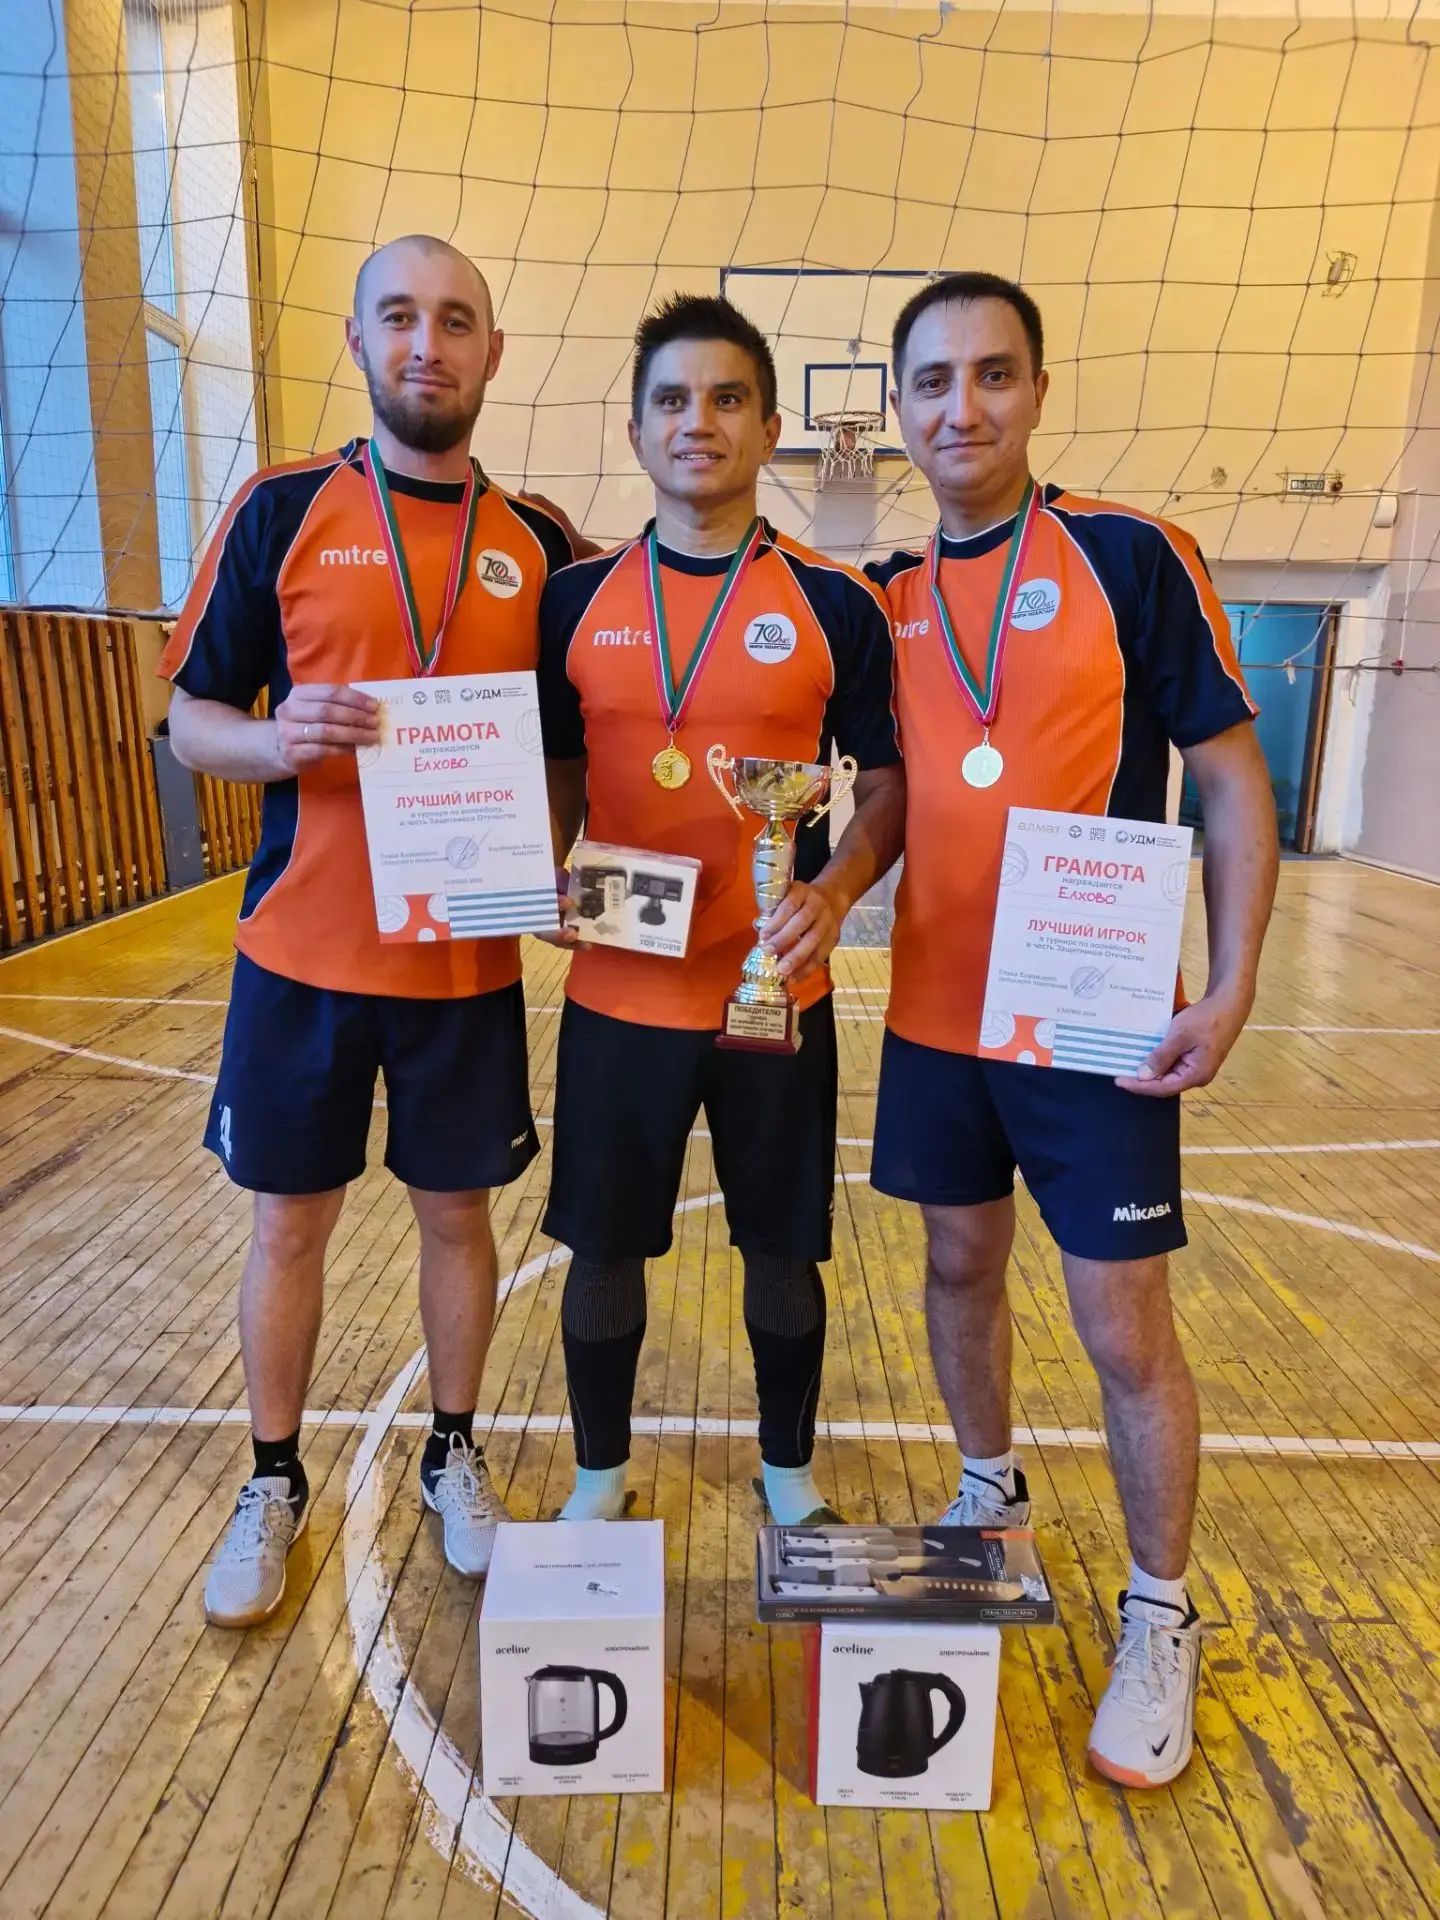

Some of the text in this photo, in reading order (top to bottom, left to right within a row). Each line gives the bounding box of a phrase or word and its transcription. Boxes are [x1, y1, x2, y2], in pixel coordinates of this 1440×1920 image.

[1292, 481, 1323, 490] ВЫХОД
[320, 544, 388, 565] mitre
[482, 556, 508, 578] 70
[1016, 590, 1046, 612] 70
[593, 625, 652, 646] mitre
[753, 623, 783, 643] 70
[474, 688, 502, 700] УДМ
[396, 721, 500, 745] ГРАМОТА
[419, 743, 480, 755] награждается
[396, 788, 515, 809] ЛУЧШИЙ ИГРОК
[417, 810, 448, 819] турнире
[1129, 833, 1156, 846] УДМ
[1043, 855, 1146, 883] ГРАМОТА
[1062, 876, 1123, 890] награждается
[1027, 919, 1147, 944] ЛУЧШИЙ ИГРОК
[1046, 937, 1077, 946] турнире
[1033, 943, 1054, 951] честь
[1105, 951, 1145, 962] Отечества
[735, 1004, 781, 1016] ПОБЕДИТЕЛЮ
[219, 1105, 232, 1162] 4
[495, 1644, 530, 1655] aceline
[832, 1643, 874, 1655] aceline
